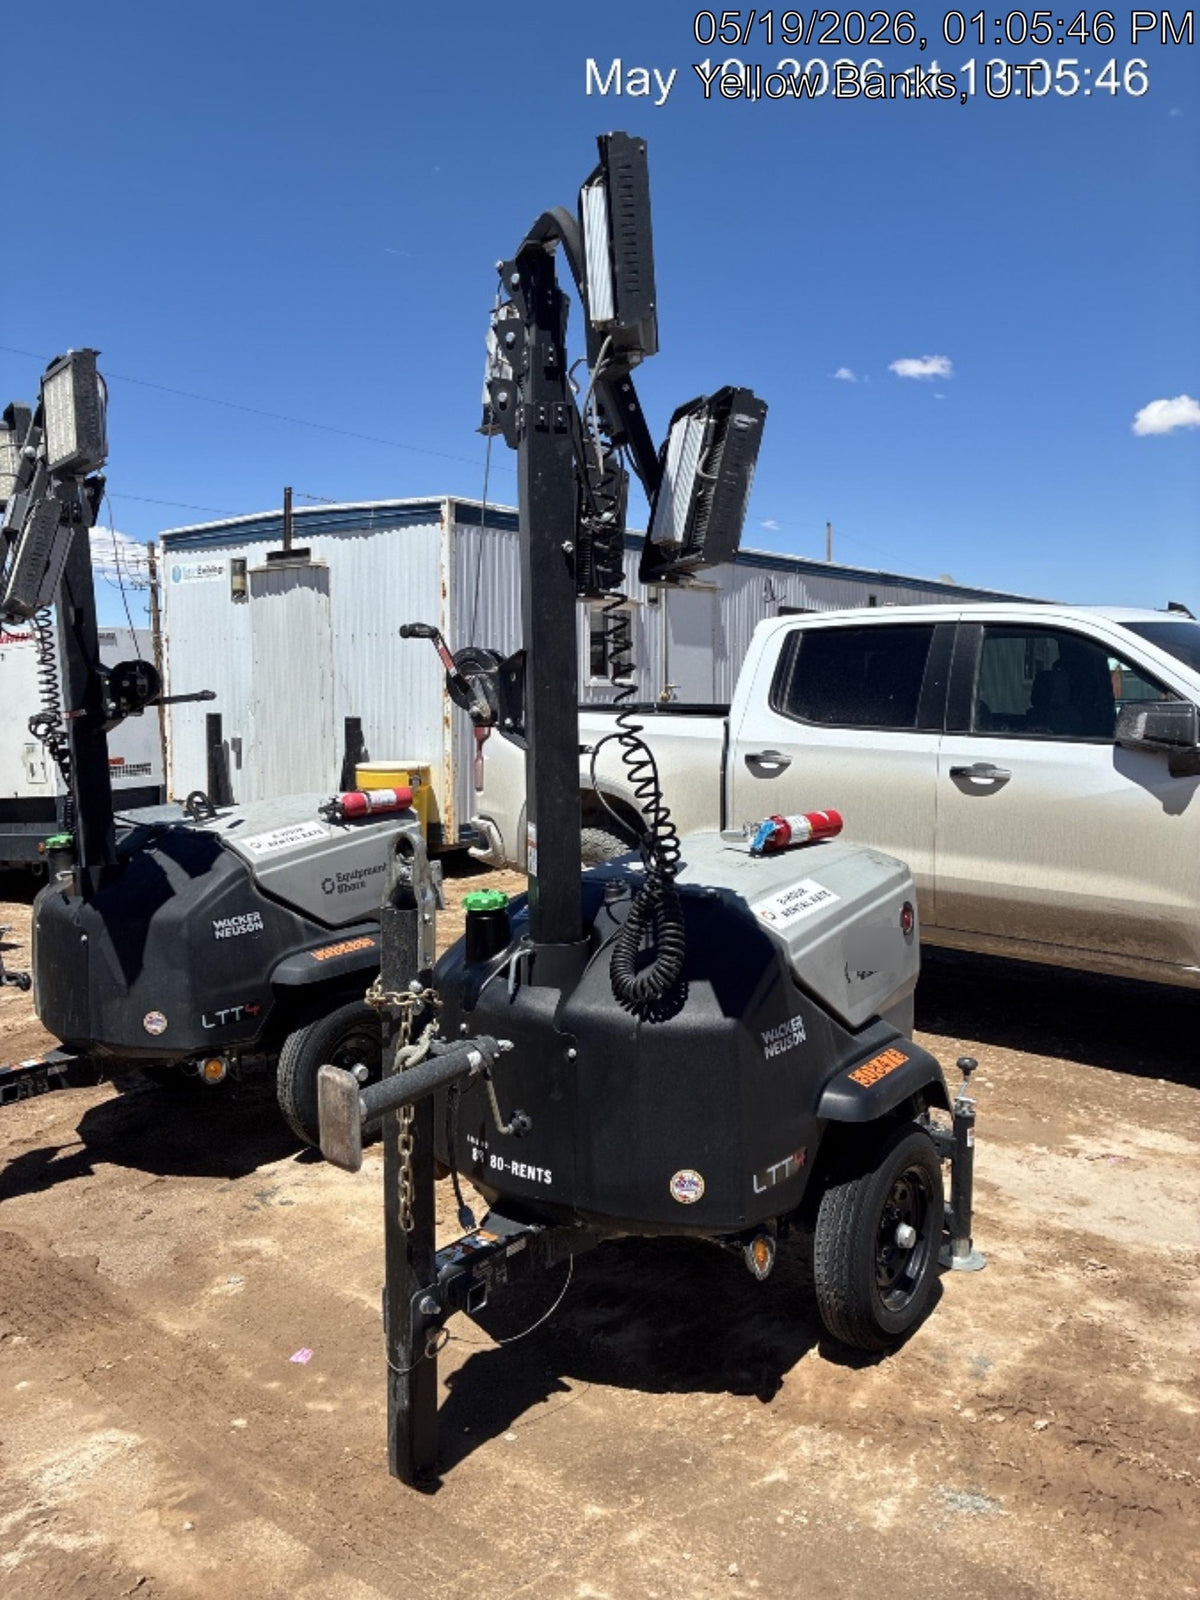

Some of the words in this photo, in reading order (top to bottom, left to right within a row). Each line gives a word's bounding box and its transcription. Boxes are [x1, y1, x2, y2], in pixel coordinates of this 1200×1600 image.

[213, 912, 262, 930] WACKER
[215, 920, 264, 940] NEUSON
[201, 1003, 260, 1029] LTT4
[761, 1014, 804, 1044] WACKER
[764, 1026, 807, 1060] NEUSON
